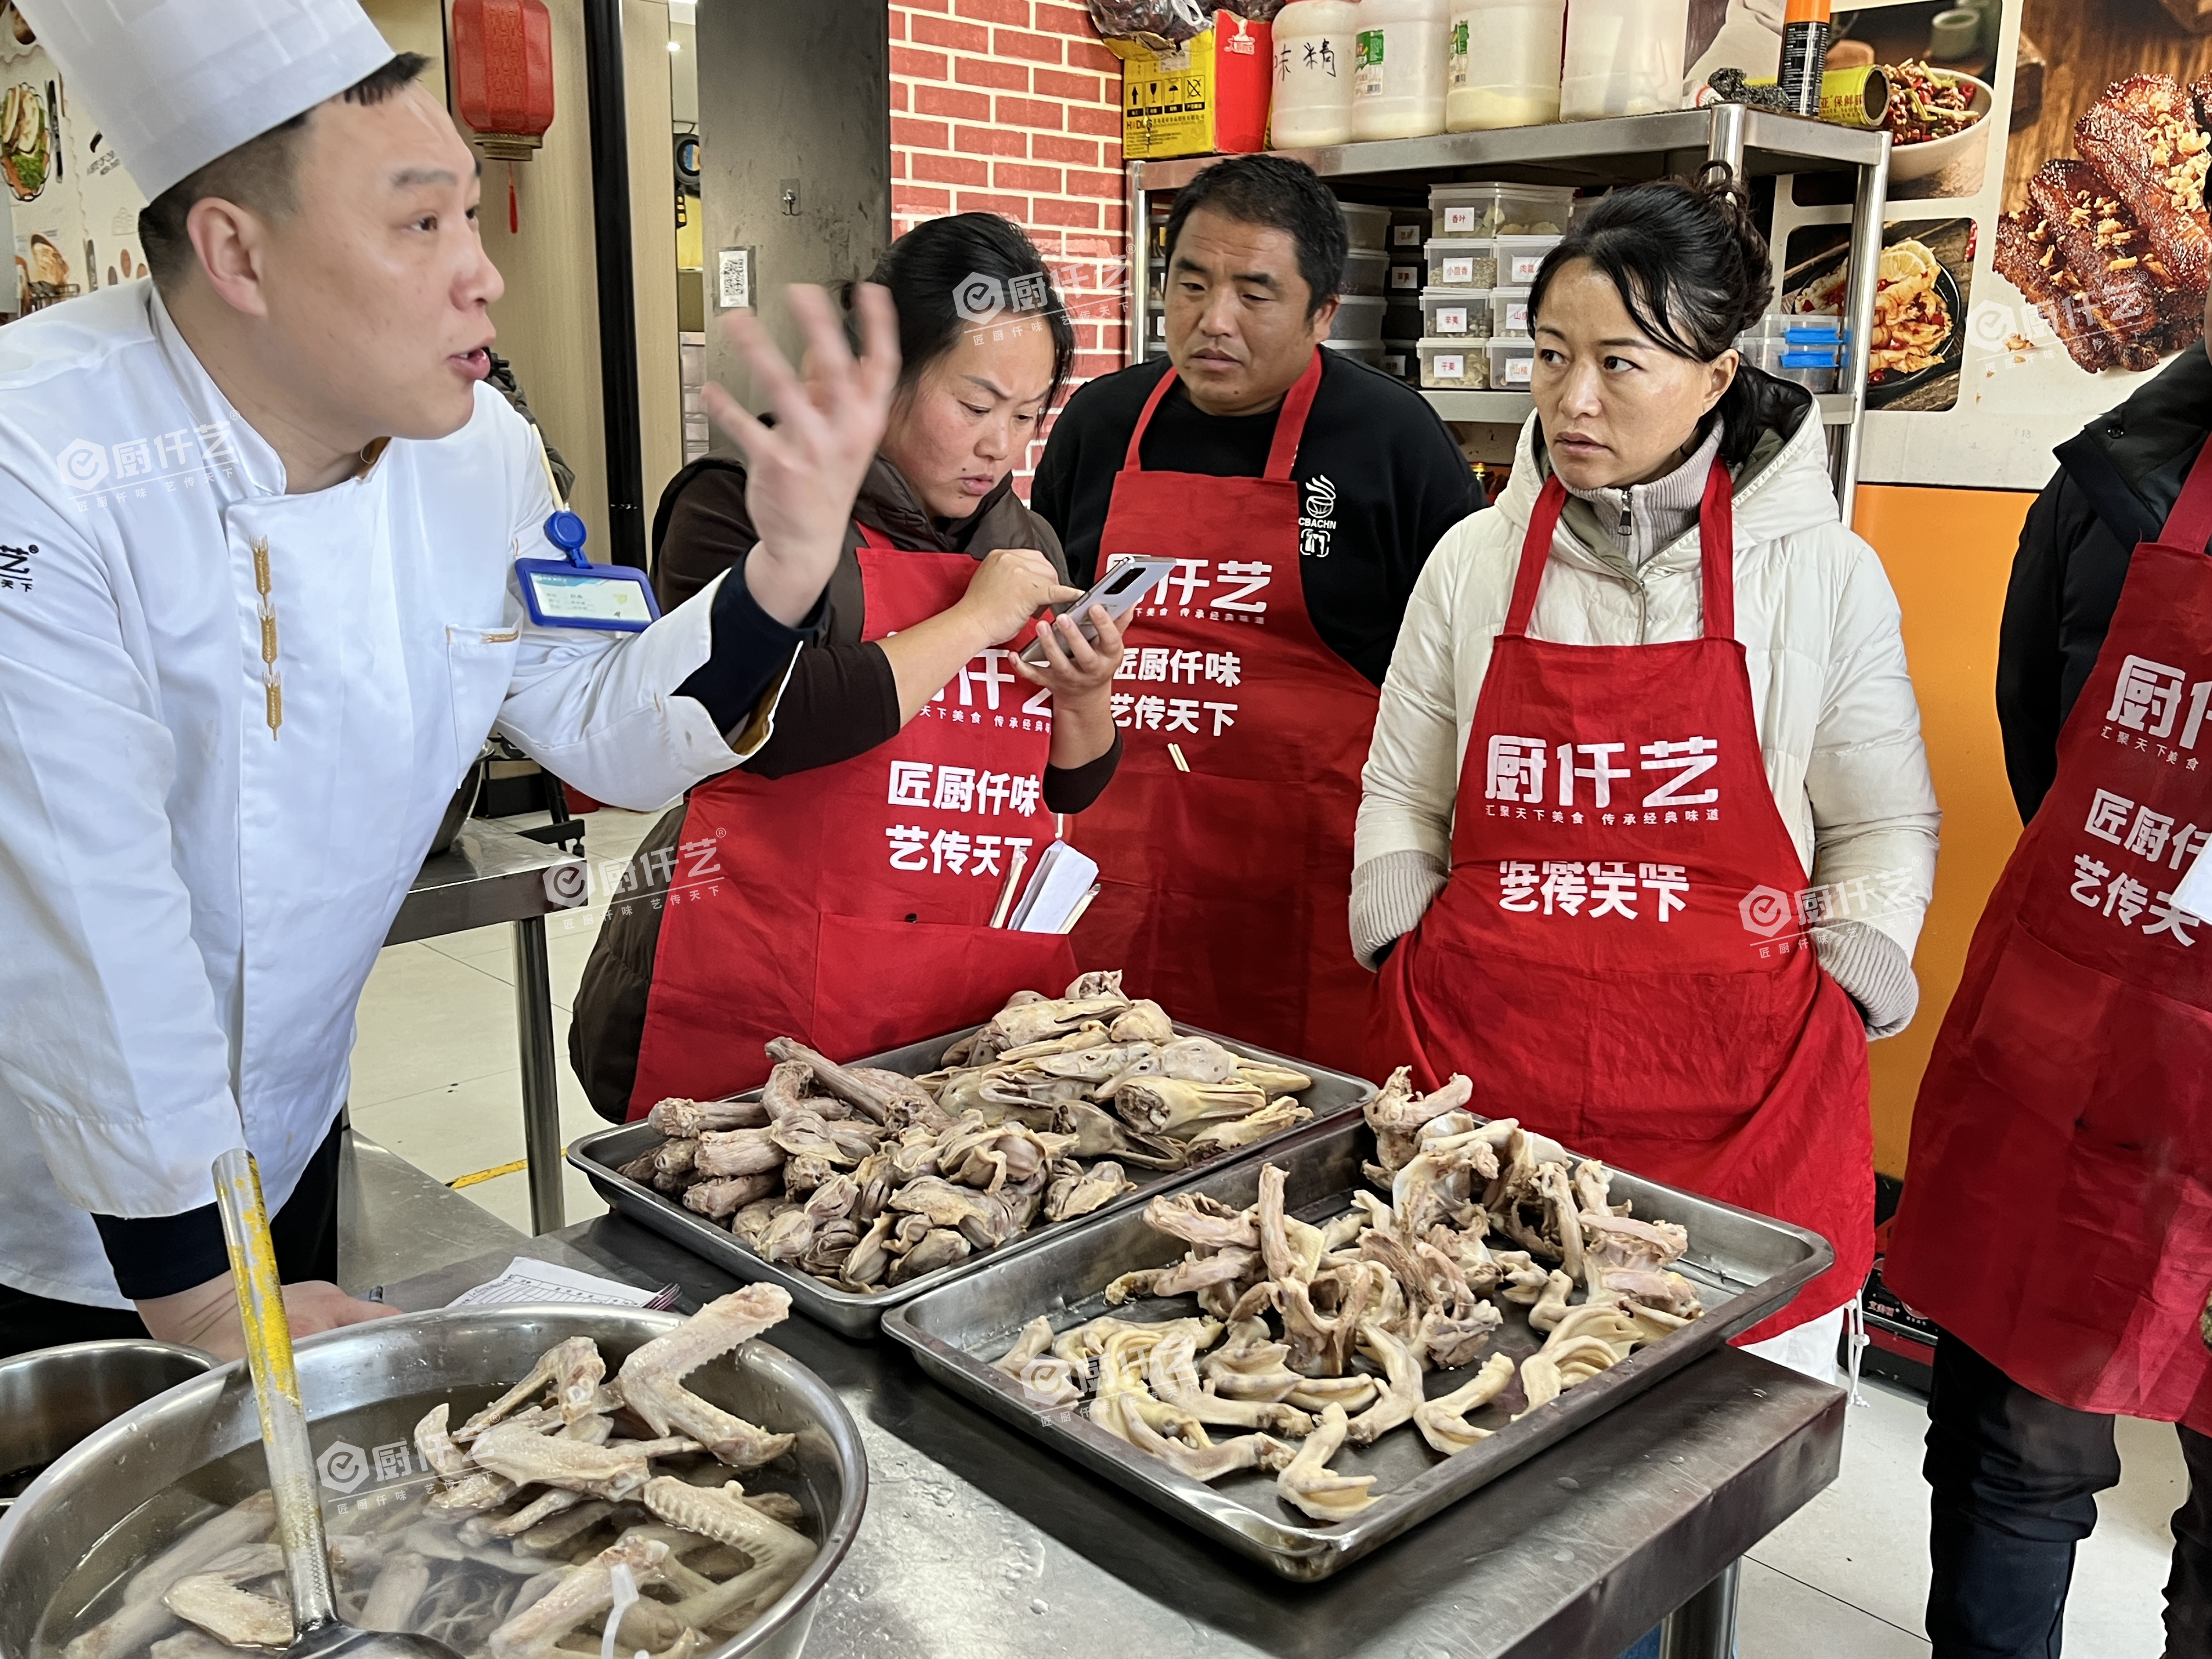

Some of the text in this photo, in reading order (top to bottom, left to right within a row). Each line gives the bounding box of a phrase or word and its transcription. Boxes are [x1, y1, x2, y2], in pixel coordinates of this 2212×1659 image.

[1298, 517, 1336, 529] CBACHN
[1106, 553, 1272, 613] 仟艺
[1113, 648, 1241, 687] 匠厨仟味
[919, 705, 1052, 735] 天下美食 传承经典
[1110, 693, 1238, 736] 艺传天下
[888, 760, 1040, 817] 匠厨仟味
[1485, 735, 1719, 808] 厨仟艺
[1485, 804, 1719, 826] 汇聚天下美食 传承经典味道
